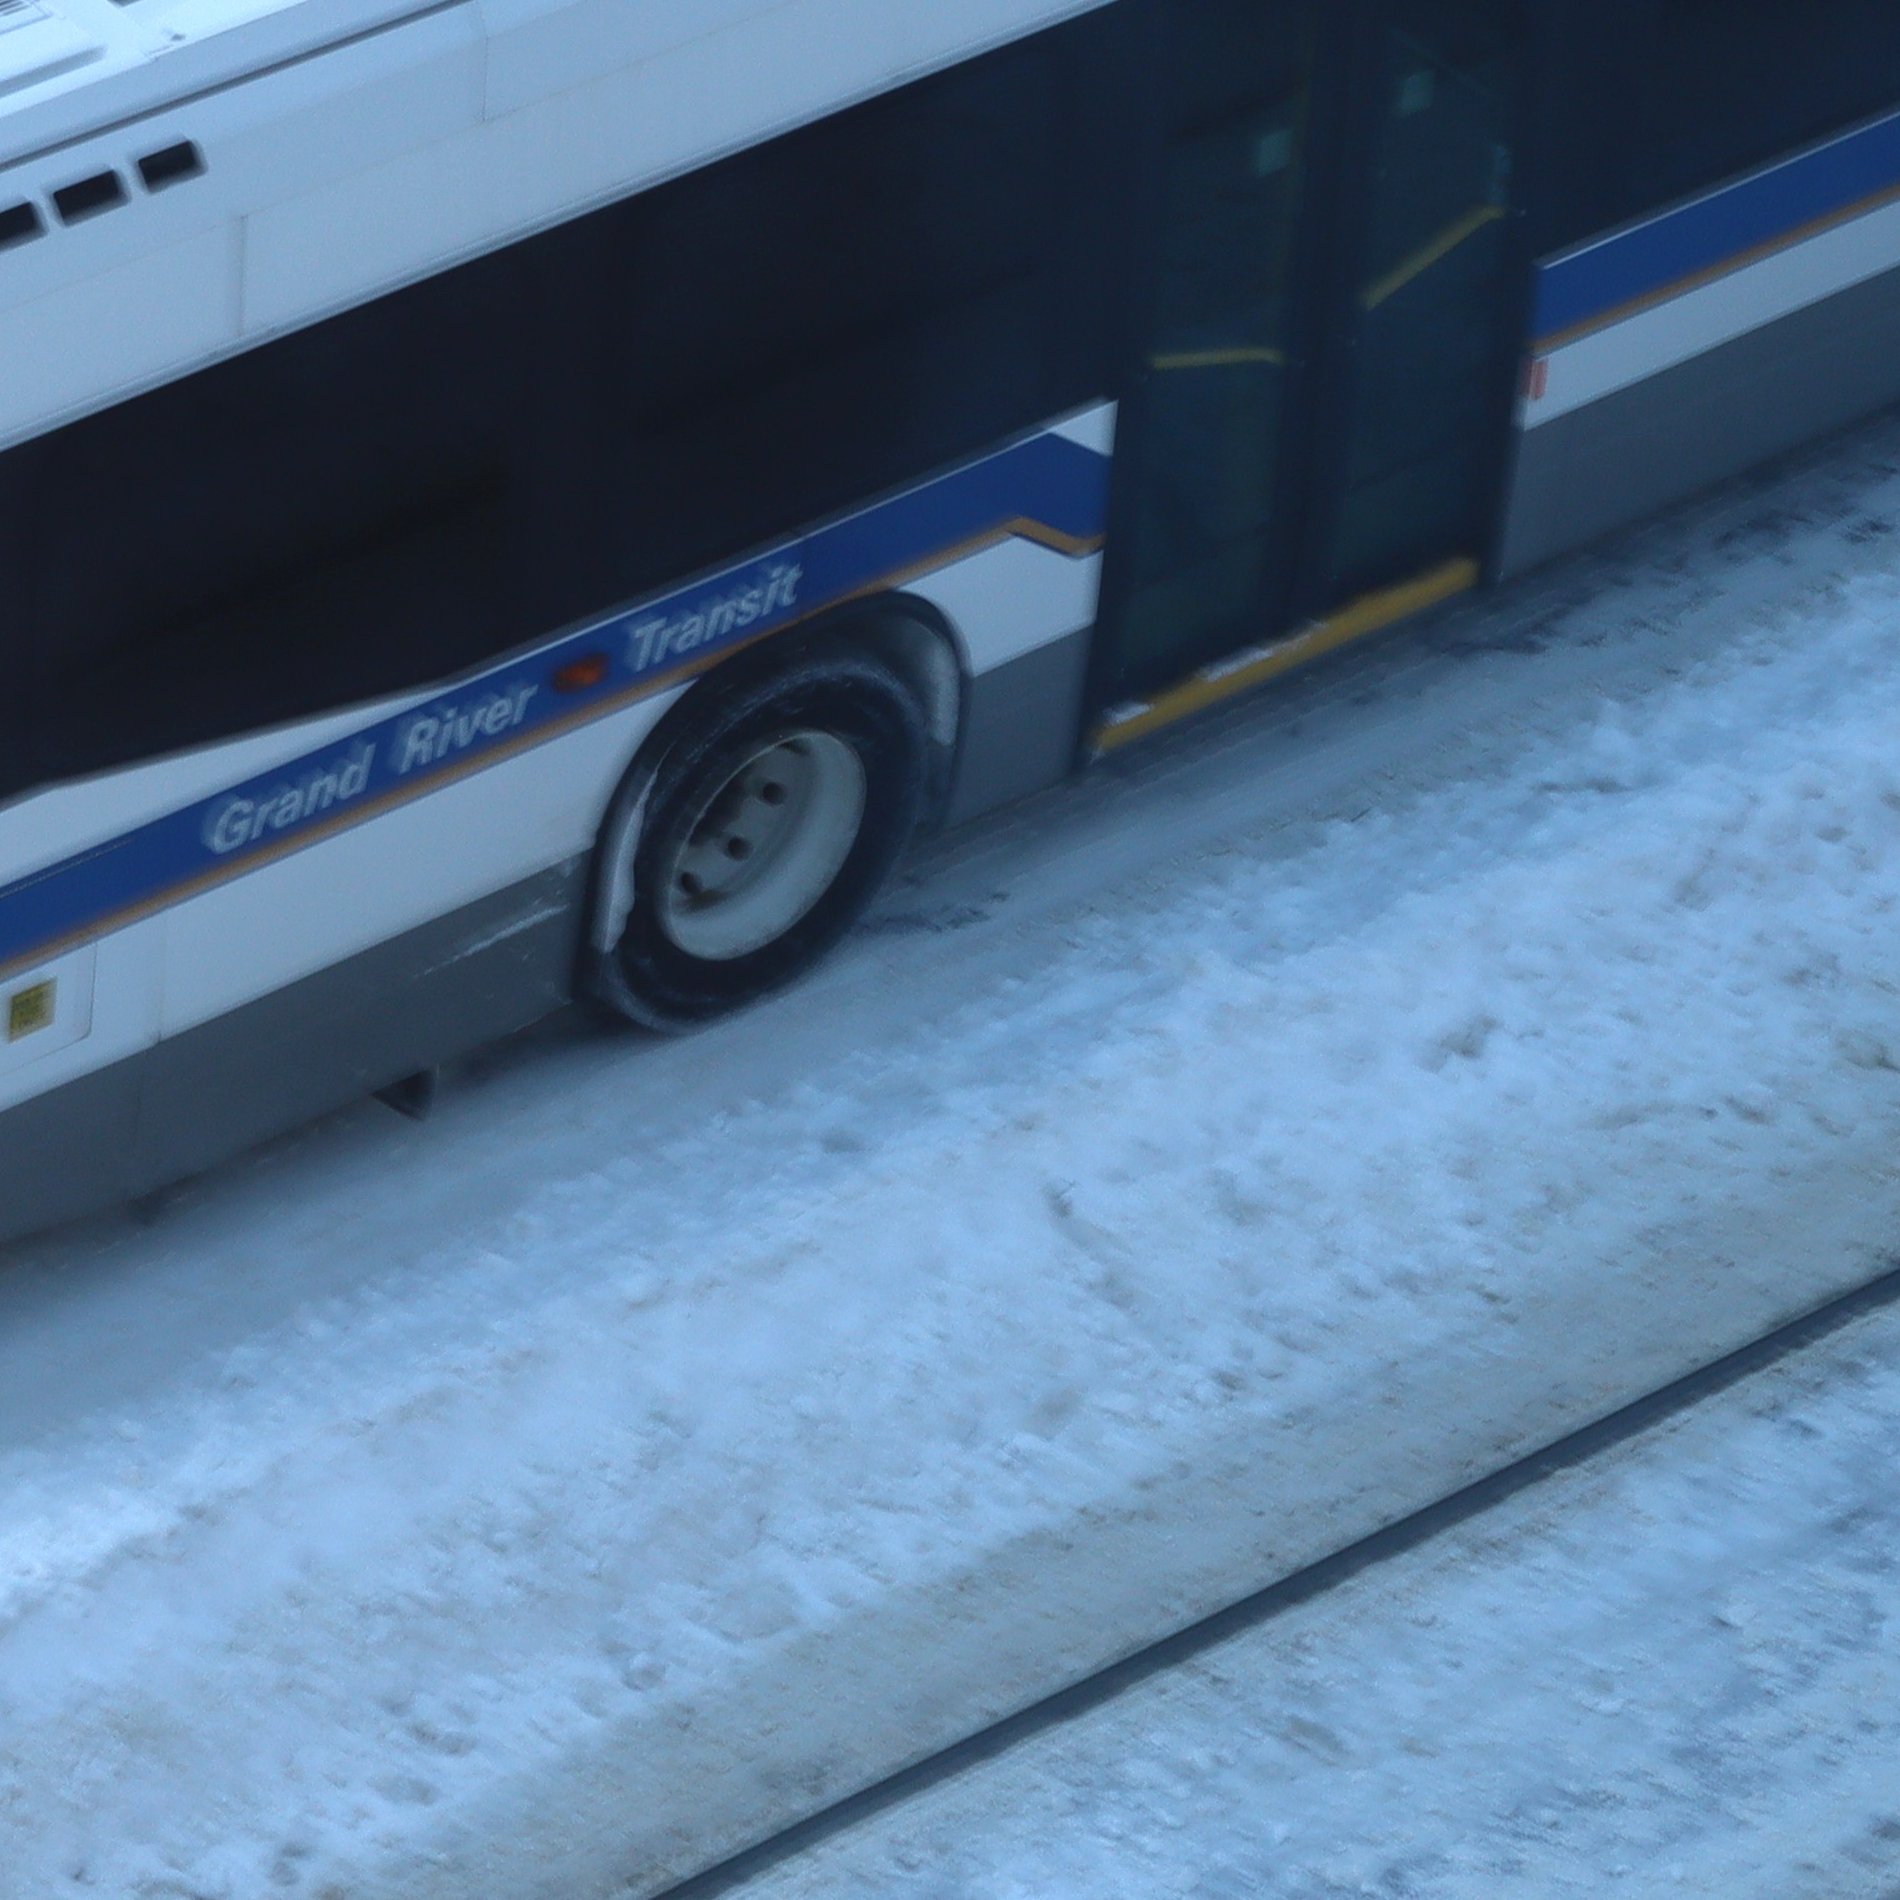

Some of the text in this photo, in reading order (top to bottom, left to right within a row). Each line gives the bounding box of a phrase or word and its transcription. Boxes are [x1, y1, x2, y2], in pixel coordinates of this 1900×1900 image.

[202, 563, 803, 856] Grand River Transit
